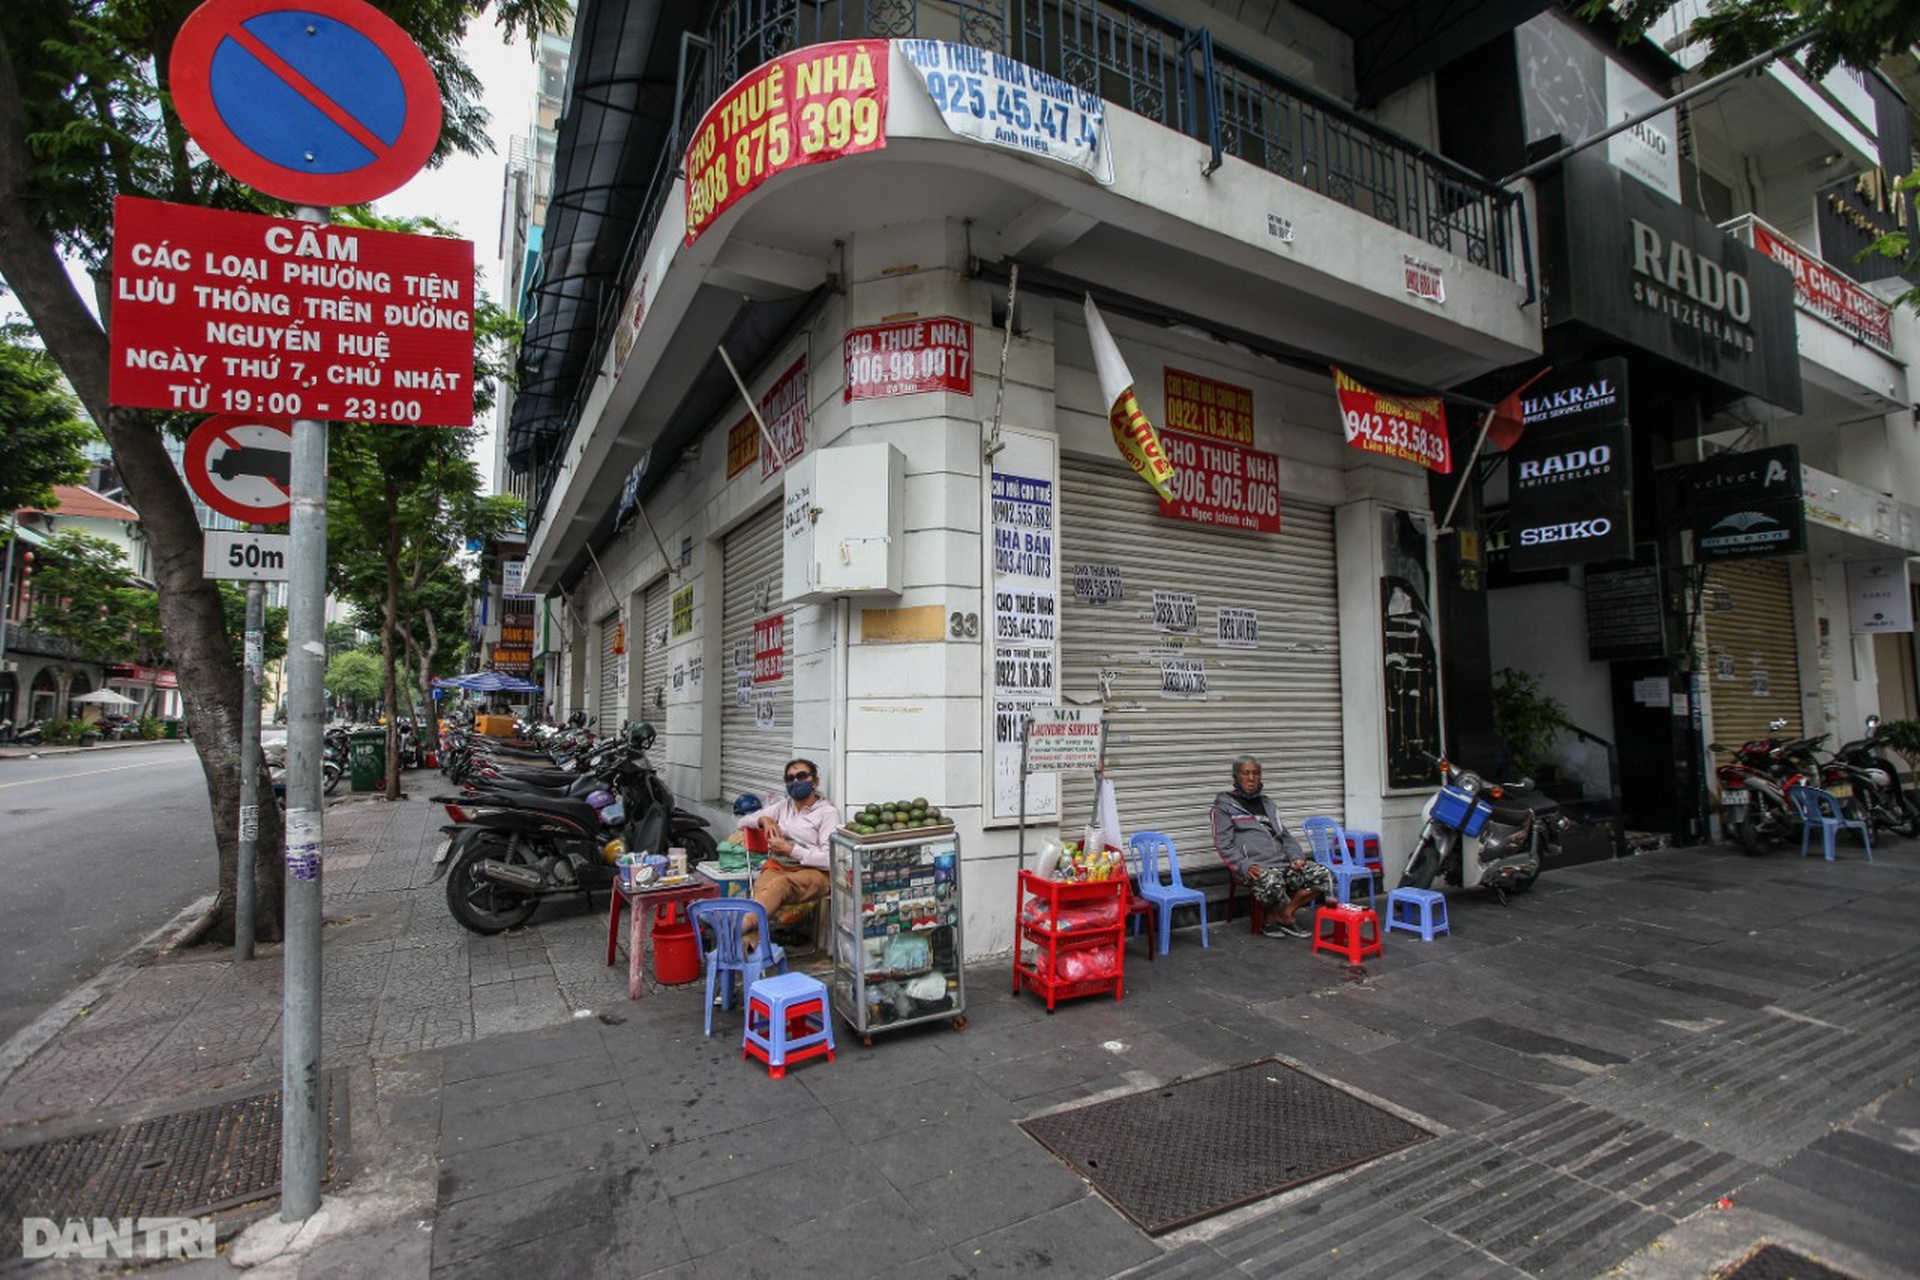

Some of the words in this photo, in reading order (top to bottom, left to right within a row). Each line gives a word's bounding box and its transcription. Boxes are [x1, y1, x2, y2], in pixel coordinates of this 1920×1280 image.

[902, 40, 940, 67] CHO
[720, 64, 785, 142] THUÊ
[796, 46, 876, 99] NHÀ
[735, 112, 789, 186] 875
[801, 97, 879, 154] 399
[995, 127, 1018, 146] Anh
[1623, 111, 1666, 156] ADO
[265, 223, 358, 262] CẤM
[132, 241, 191, 272] CÁC
[205, 252, 267, 283] LOẠI
[283, 262, 391, 294] PHƯƠNG
[404, 272, 459, 303] TIỆN
[1630, 217, 1751, 325] RADO
[1809, 267, 1841, 302] CHO
[119, 276, 175, 305] LƯU
[194, 284, 290, 316] THÔNG
[304, 297, 372, 324] TRÊN
[384, 301, 469, 331] ĐƯỜNG
[1634, 281, 1754, 353] SWITZERLAND
[206, 319, 321, 352] NGUYỄN
[338, 331, 390, 363] HUỆ
[878, 323, 925, 353] THUÊ
[930, 323, 969, 349] NHÀ
[126, 347, 207, 373] NGÀY
[223, 356, 280, 380] THỨ
[327, 361, 381, 386] CHỦ
[394, 368, 461, 395] NHẬT
[168, 378, 210, 409] TỪ
[221, 388, 301, 415] 19:00
[344, 398, 421, 421] 23:00
[1520, 379, 1616, 416] HAKRAL
[1345, 410, 1445, 463] 942.33.58.33
[1161, 437, 1196, 467] CHO
[1200, 445, 1243, 476] THUÊ
[1247, 455, 1278, 484] NHÀ
[1519, 445, 1611, 480] RADO
[1519, 465, 1611, 488] SWITZERLAND
[1167, 468, 1278, 517] 906.905.006
[995, 526, 1020, 551] NHÀ
[1025, 531, 1051, 556] BÁN
[1520, 518, 1612, 546] SEIKO
[228, 544, 284, 568] 50m
[996, 592, 1013, 612] CHO
[950, 611, 979, 637] 33
[1030, 723, 1067, 736] LAUNDRY
[1067, 723, 1099, 736] SERVICE
